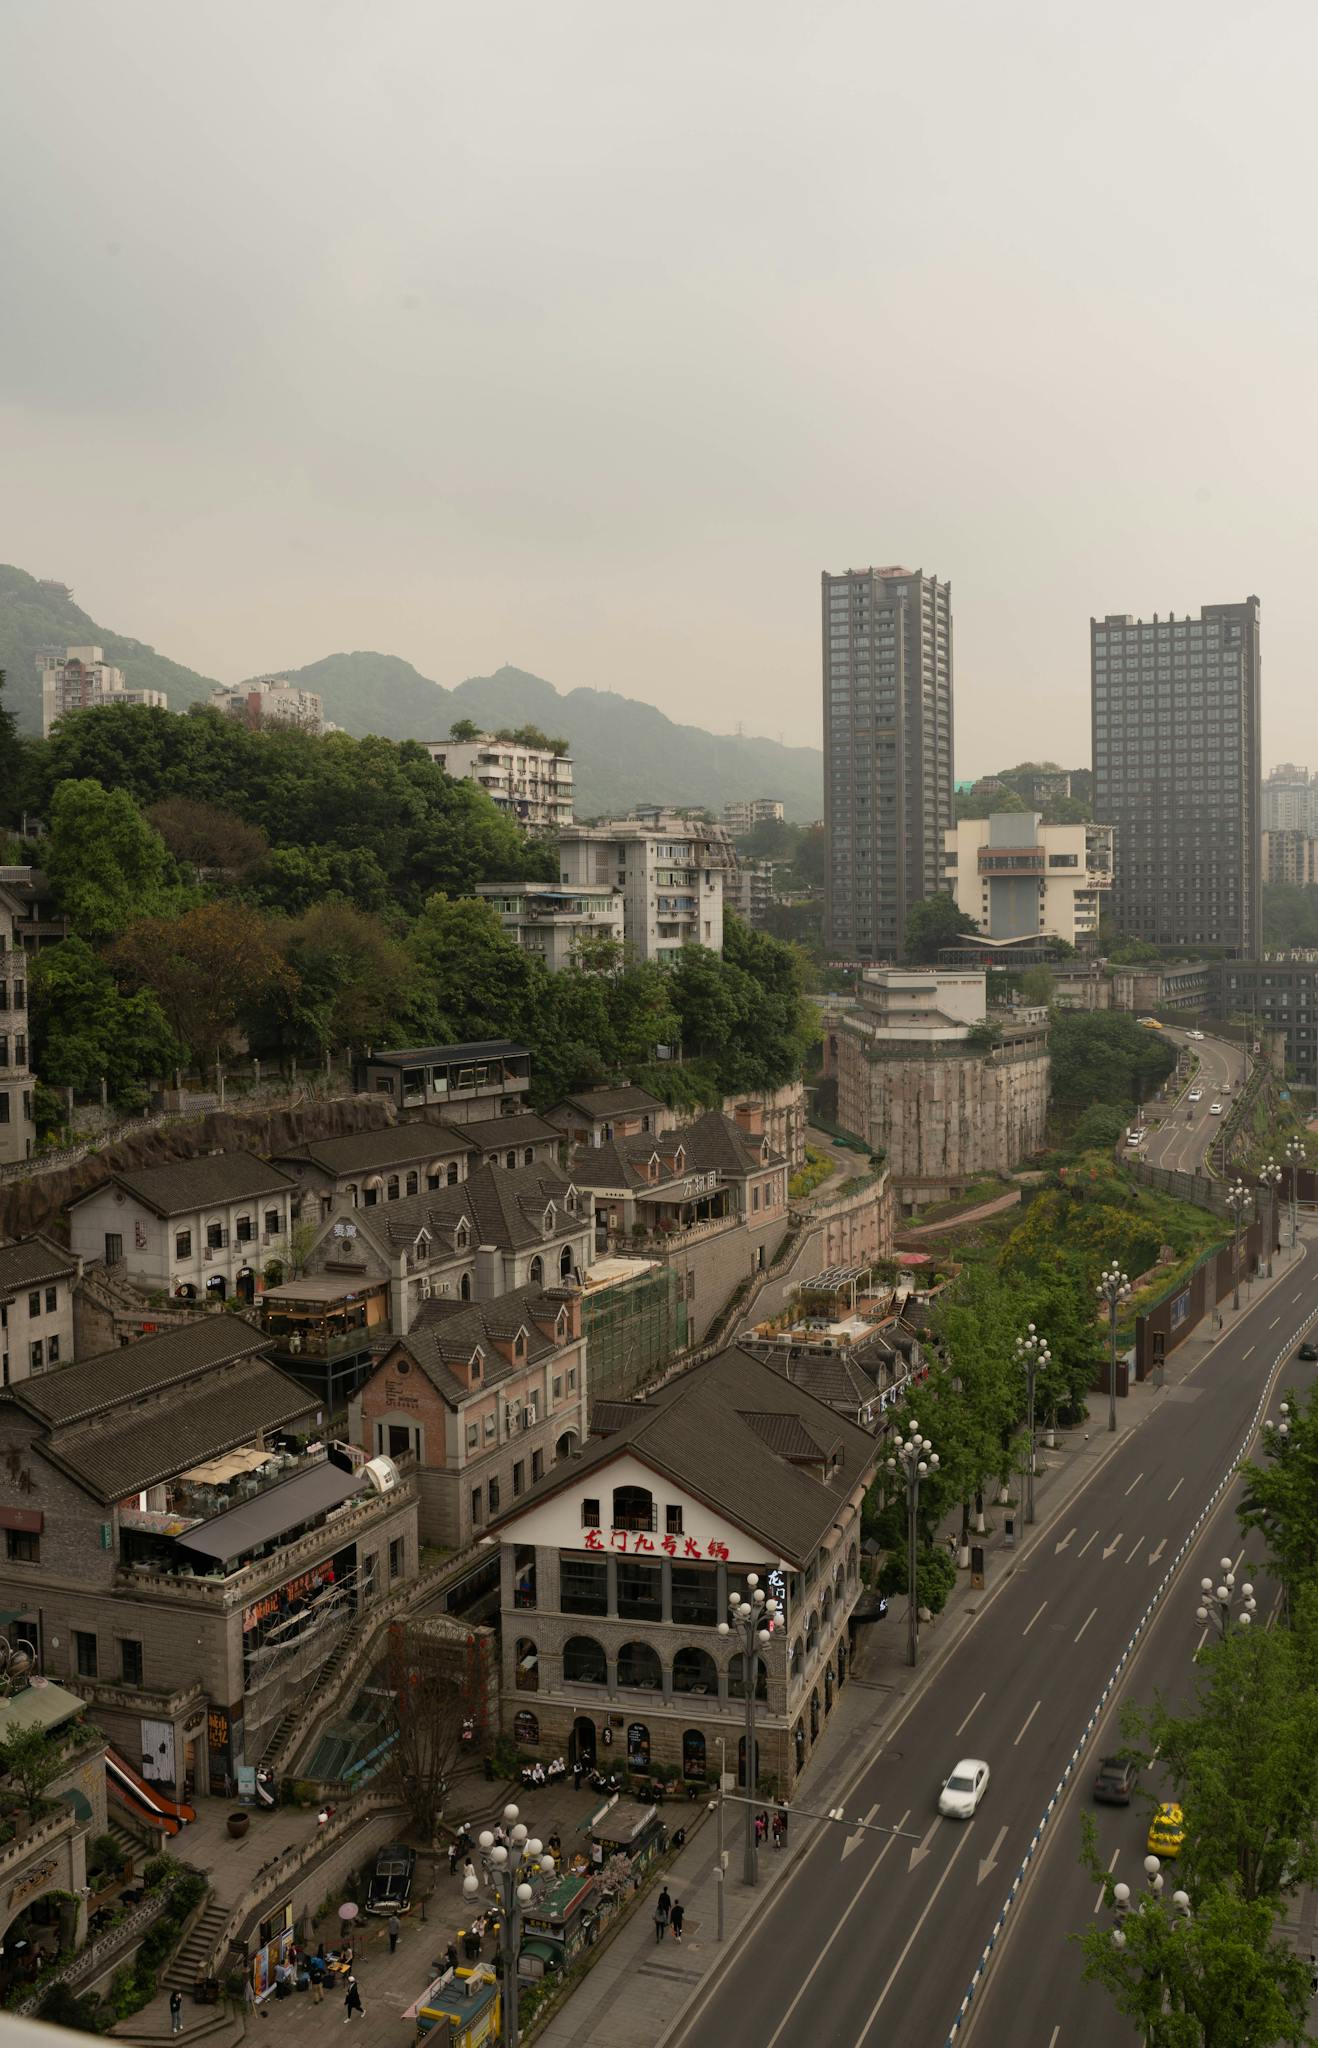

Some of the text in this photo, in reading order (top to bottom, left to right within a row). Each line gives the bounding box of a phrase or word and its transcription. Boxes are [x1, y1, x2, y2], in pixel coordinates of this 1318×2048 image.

[584, 1529, 730, 1561] 龙门九号火锅
